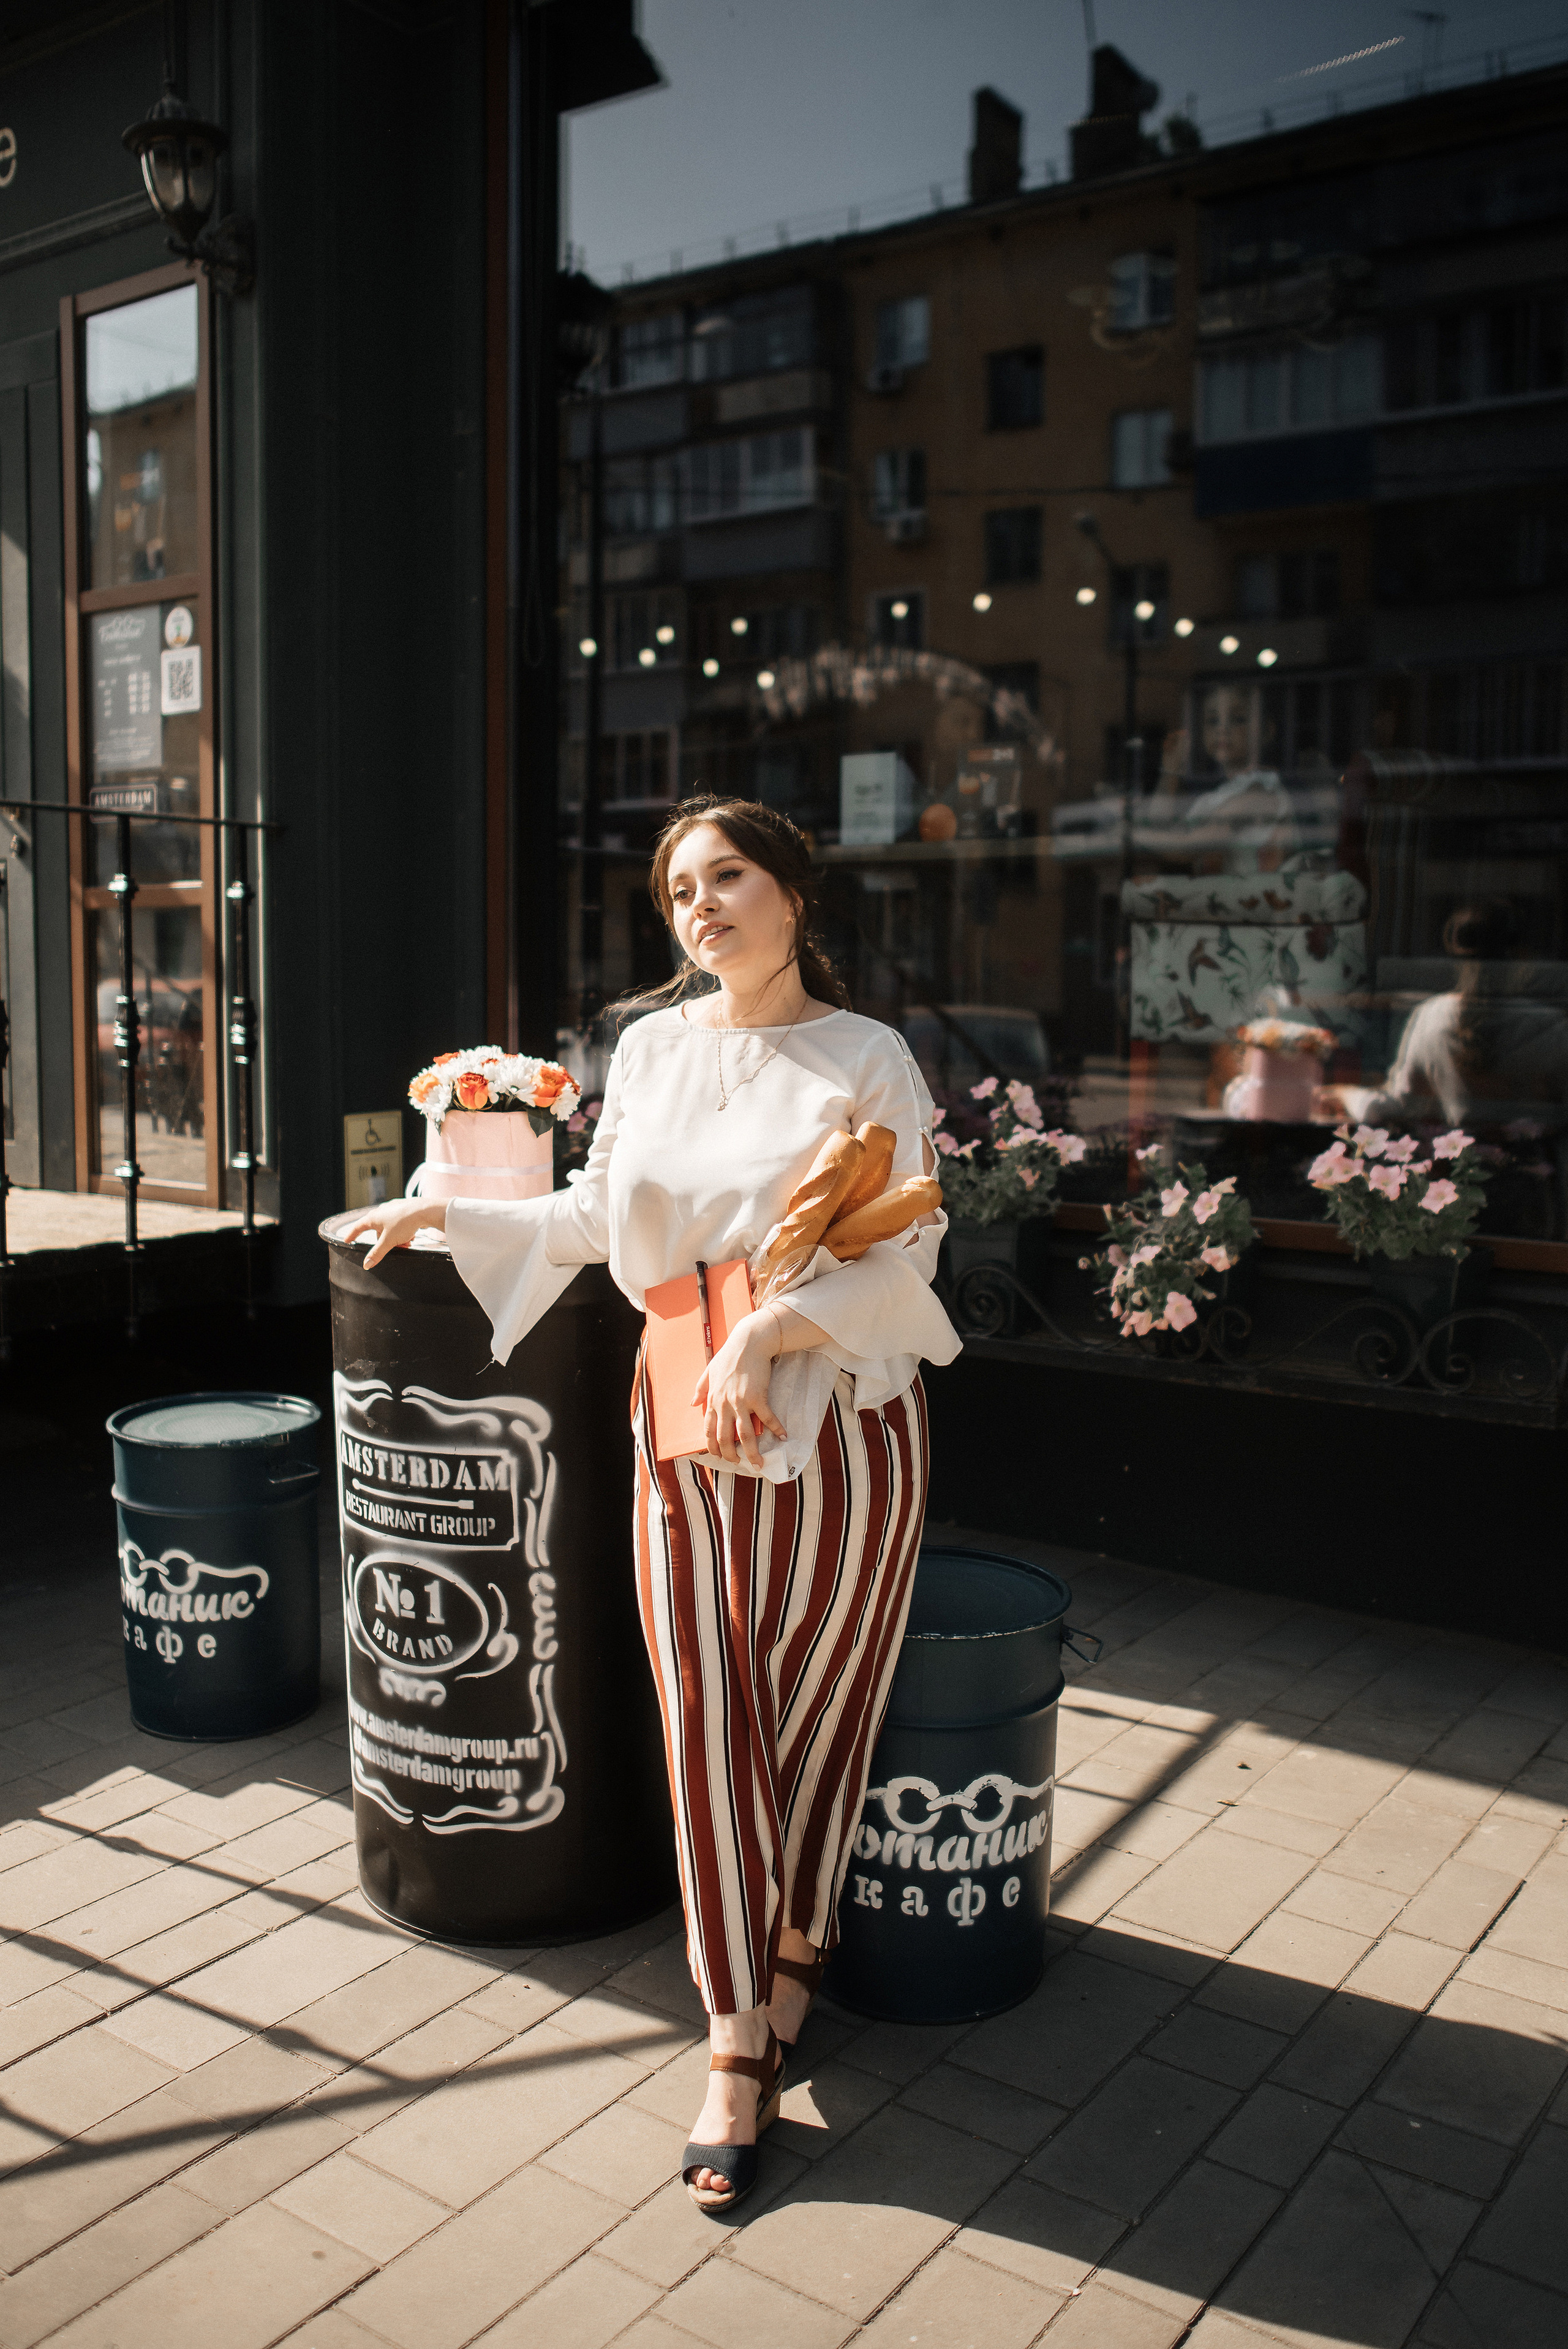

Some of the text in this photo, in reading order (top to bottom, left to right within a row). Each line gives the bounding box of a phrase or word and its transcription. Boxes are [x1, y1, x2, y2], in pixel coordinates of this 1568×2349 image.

[94, 790, 151, 807] AMSTERDAM
[341, 1434, 510, 1491] AMSTERDAM
[345, 1489, 496, 1537] RESTAURANT GROUP
[120, 1576, 254, 1622] отаник
[372, 1617, 453, 1659] BRAND
[853, 1810, 1048, 1870] отаник
[854, 1874, 1020, 1926] кафе
